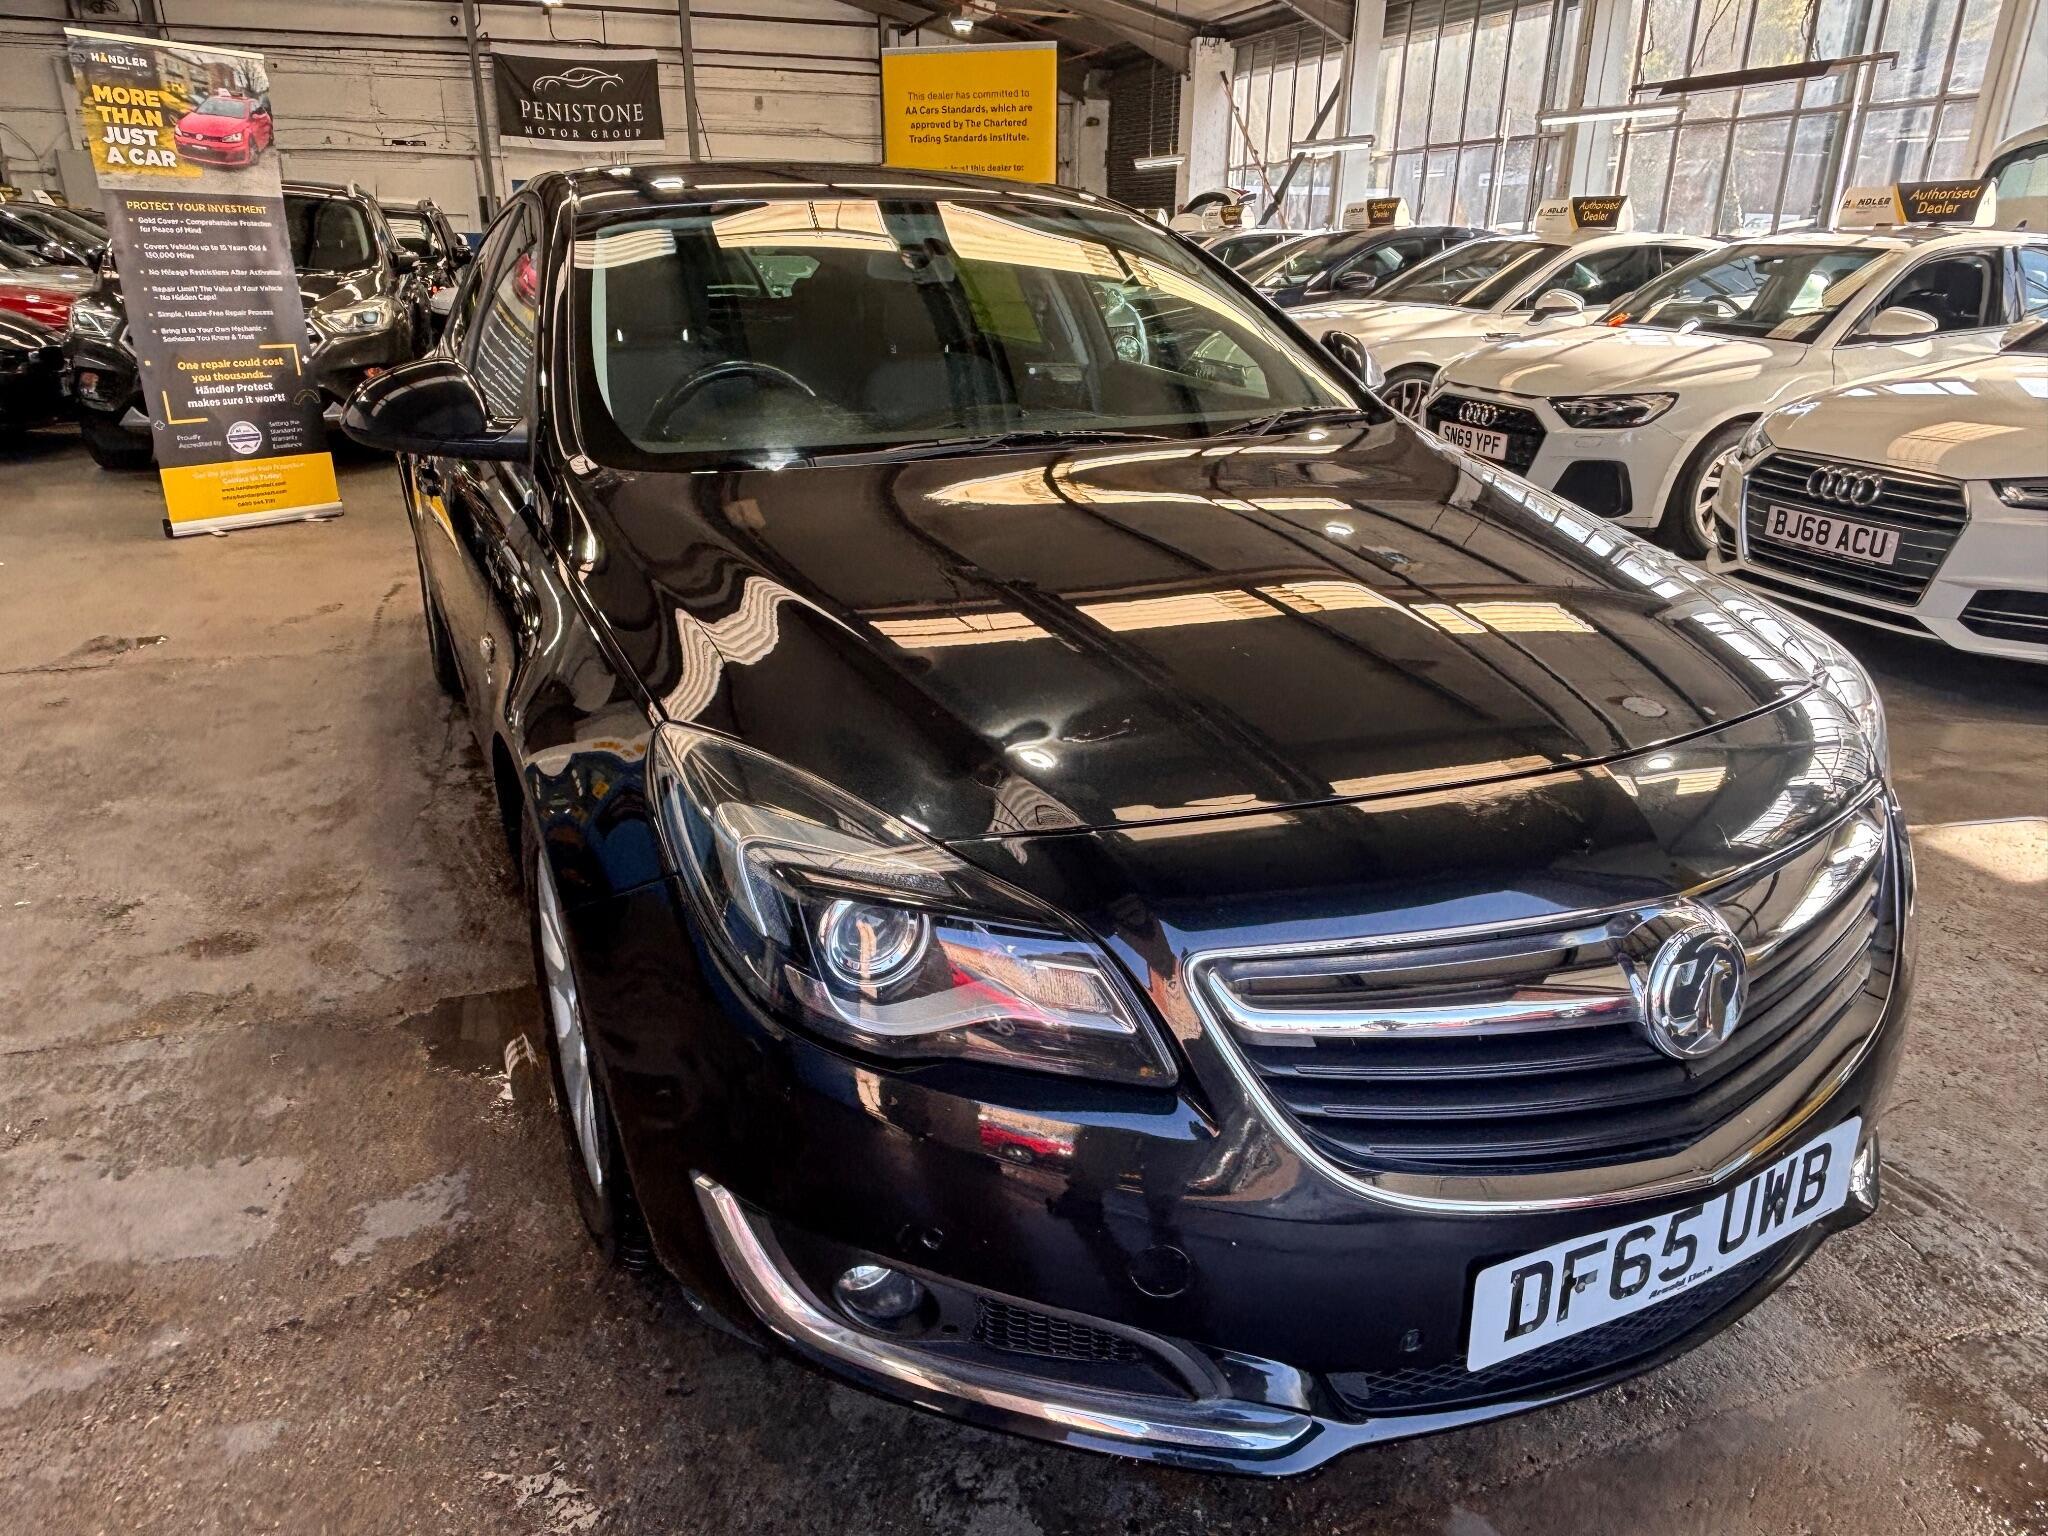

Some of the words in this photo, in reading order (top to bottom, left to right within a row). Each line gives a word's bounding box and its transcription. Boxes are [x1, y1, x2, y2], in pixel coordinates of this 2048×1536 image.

[92, 85, 160, 107] MORE
[908, 92, 925, 101] This
[927, 91, 953, 100] dealer
[956, 91, 970, 99] has
[972, 89, 1019, 99] committed
[1021, 89, 1030, 97] to
[520, 99, 644, 123] PENISTONE
[905, 106, 918, 115] AA
[919, 106, 939, 114] Cars
[941, 105, 988, 114] Standards,
[990, 104, 1017, 113] which
[96, 106, 163, 127] THAN
[910, 120, 951, 131] approved
[953, 119, 963, 130] by
[965, 119, 981, 128] The
[983, 118, 1027, 127] Chartered
[103, 126, 158, 146] JUST
[525, 126, 580, 139] MOTOR
[591, 128, 641, 139] GROUP
[909, 134, 941, 145] Trading
[943, 134, 988, 143] Standards
[989, 133, 1029, 142] Institute.
[107, 147, 126, 164] A
[129, 149, 177, 168] CAR
[1910, 185, 1981, 201] Authorised
[126, 201, 174, 211] PROTECT
[177, 202, 206, 212] YOUR
[207, 204, 267, 214] INVESTMENT
[1579, 200, 1621, 210] Authorised
[1916, 201, 1961, 214] Dealer
[1583, 211, 1609, 221] Dealer
[161, 269, 189, 277] Mileage
[177, 361, 199, 370] One
[201, 359, 230, 370] repair
[233, 358, 261, 368] could
[262, 357, 284, 366] cost
[192, 374, 212, 384] you
[237, 382, 274, 392] Protect
[188, 399, 221, 409] makes
[222, 397, 244, 406] sure
[245, 395, 254, 404] it
[1444, 425, 1472, 448] SN69
[1476, 432, 1501, 454] YPF
[1773, 509, 1832, 545] BJ68
[1835, 524, 1888, 558] ACU
[1504, 1204, 1705, 1343] DF65
[1717, 1141, 1833, 1255] UWB
